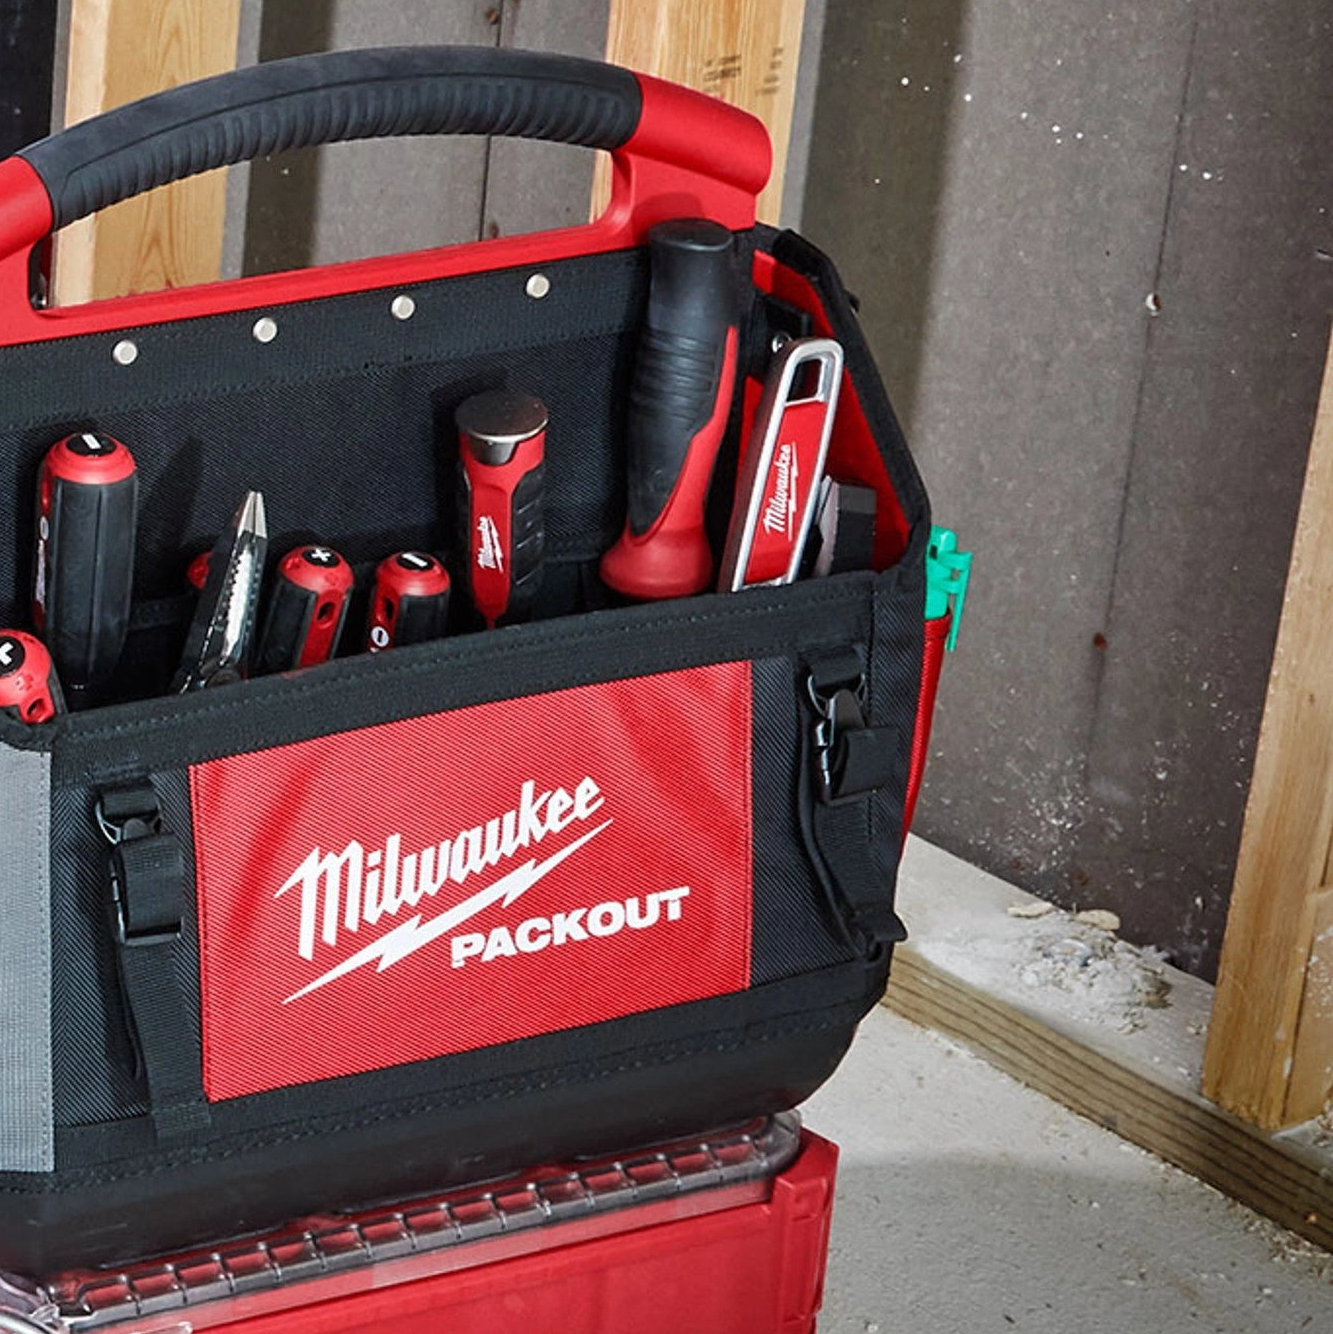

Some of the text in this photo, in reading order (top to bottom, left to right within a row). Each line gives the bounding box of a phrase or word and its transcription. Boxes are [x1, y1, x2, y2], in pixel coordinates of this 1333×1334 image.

[762, 443, 792, 534] Milwaukee
[274, 775, 605, 961] Milwaukee
[451, 885, 690, 969] PACKOUT
